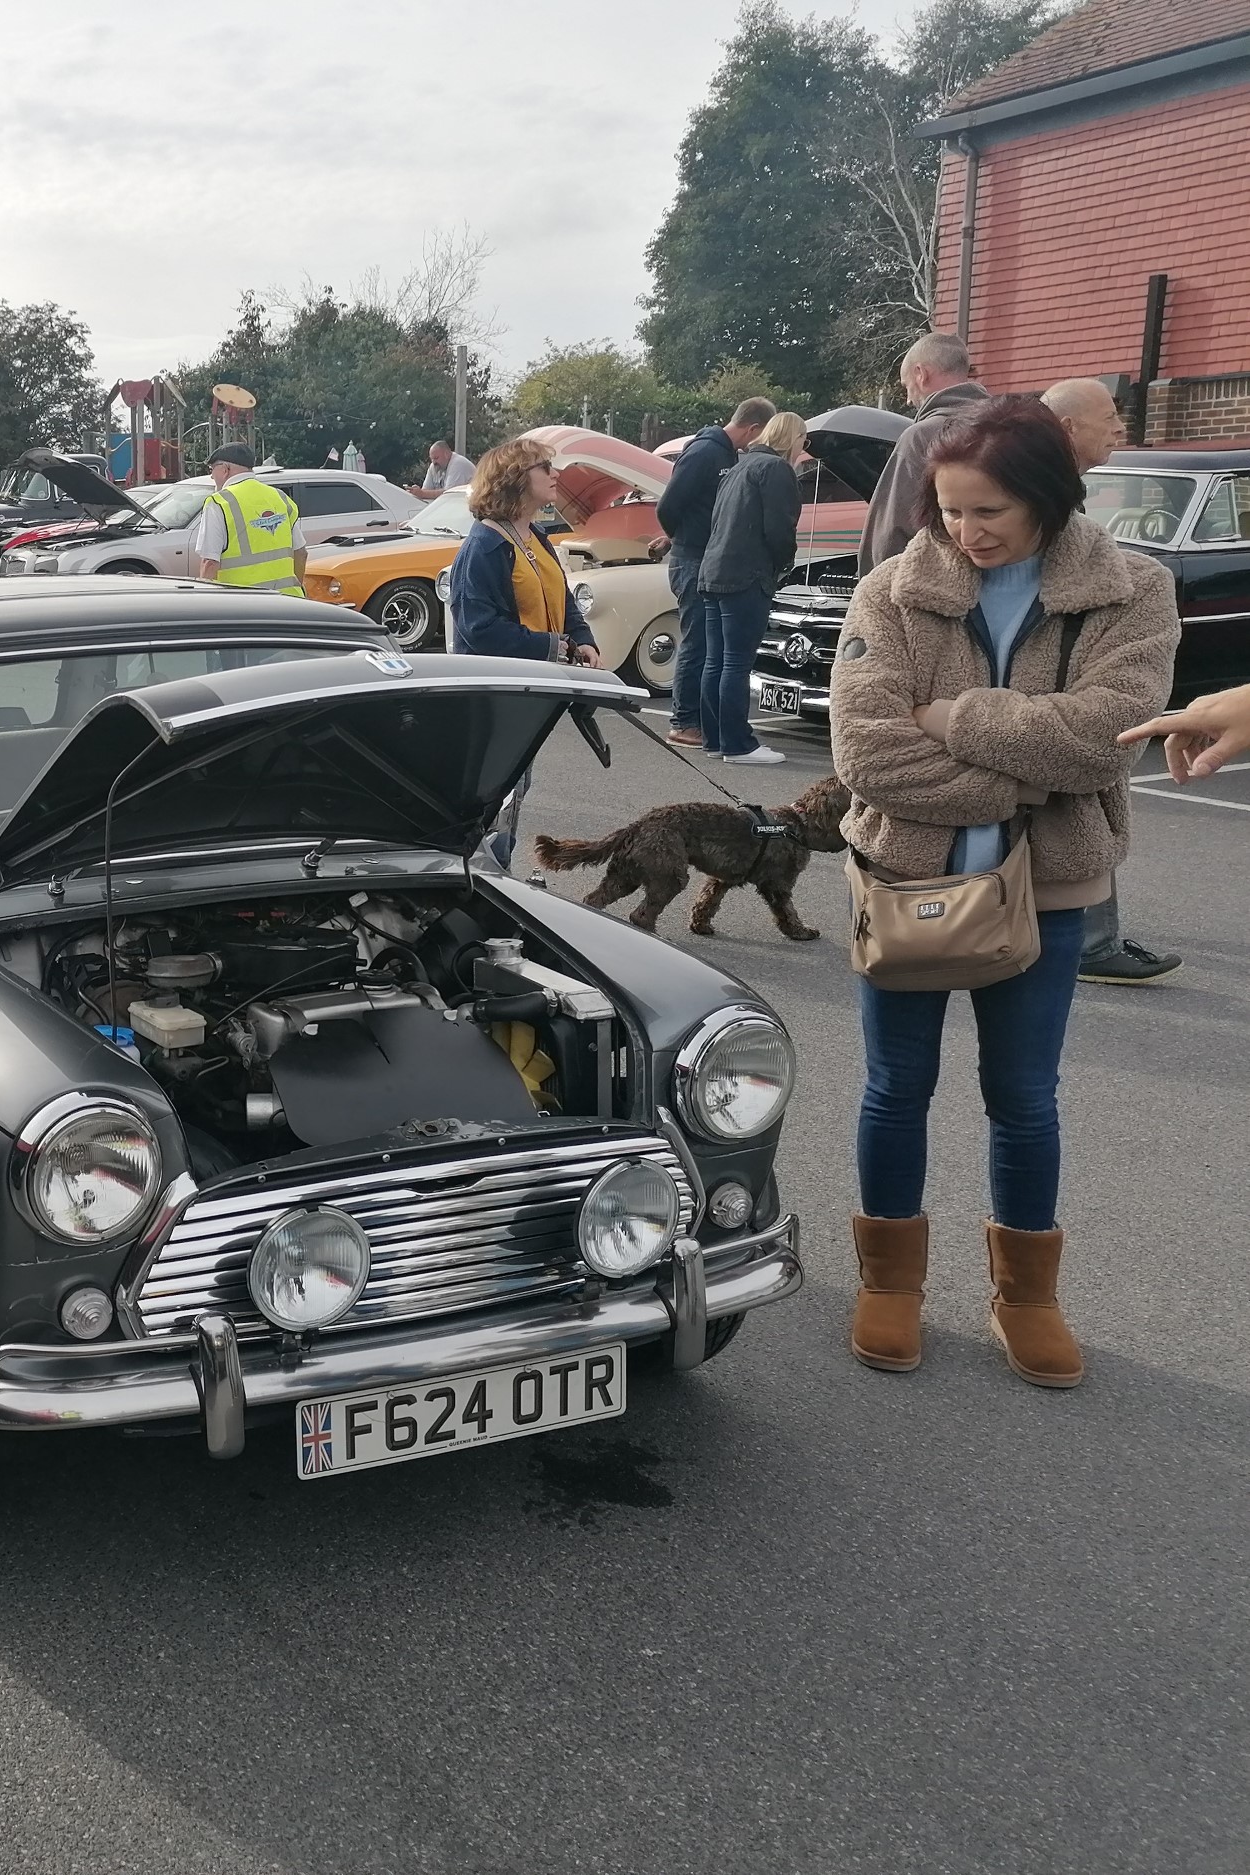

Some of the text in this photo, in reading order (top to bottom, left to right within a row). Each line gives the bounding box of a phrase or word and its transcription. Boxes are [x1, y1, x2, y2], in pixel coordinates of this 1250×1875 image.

[761, 687, 798, 710] XSK 521
[344, 1354, 615, 1461] F624 OTR
